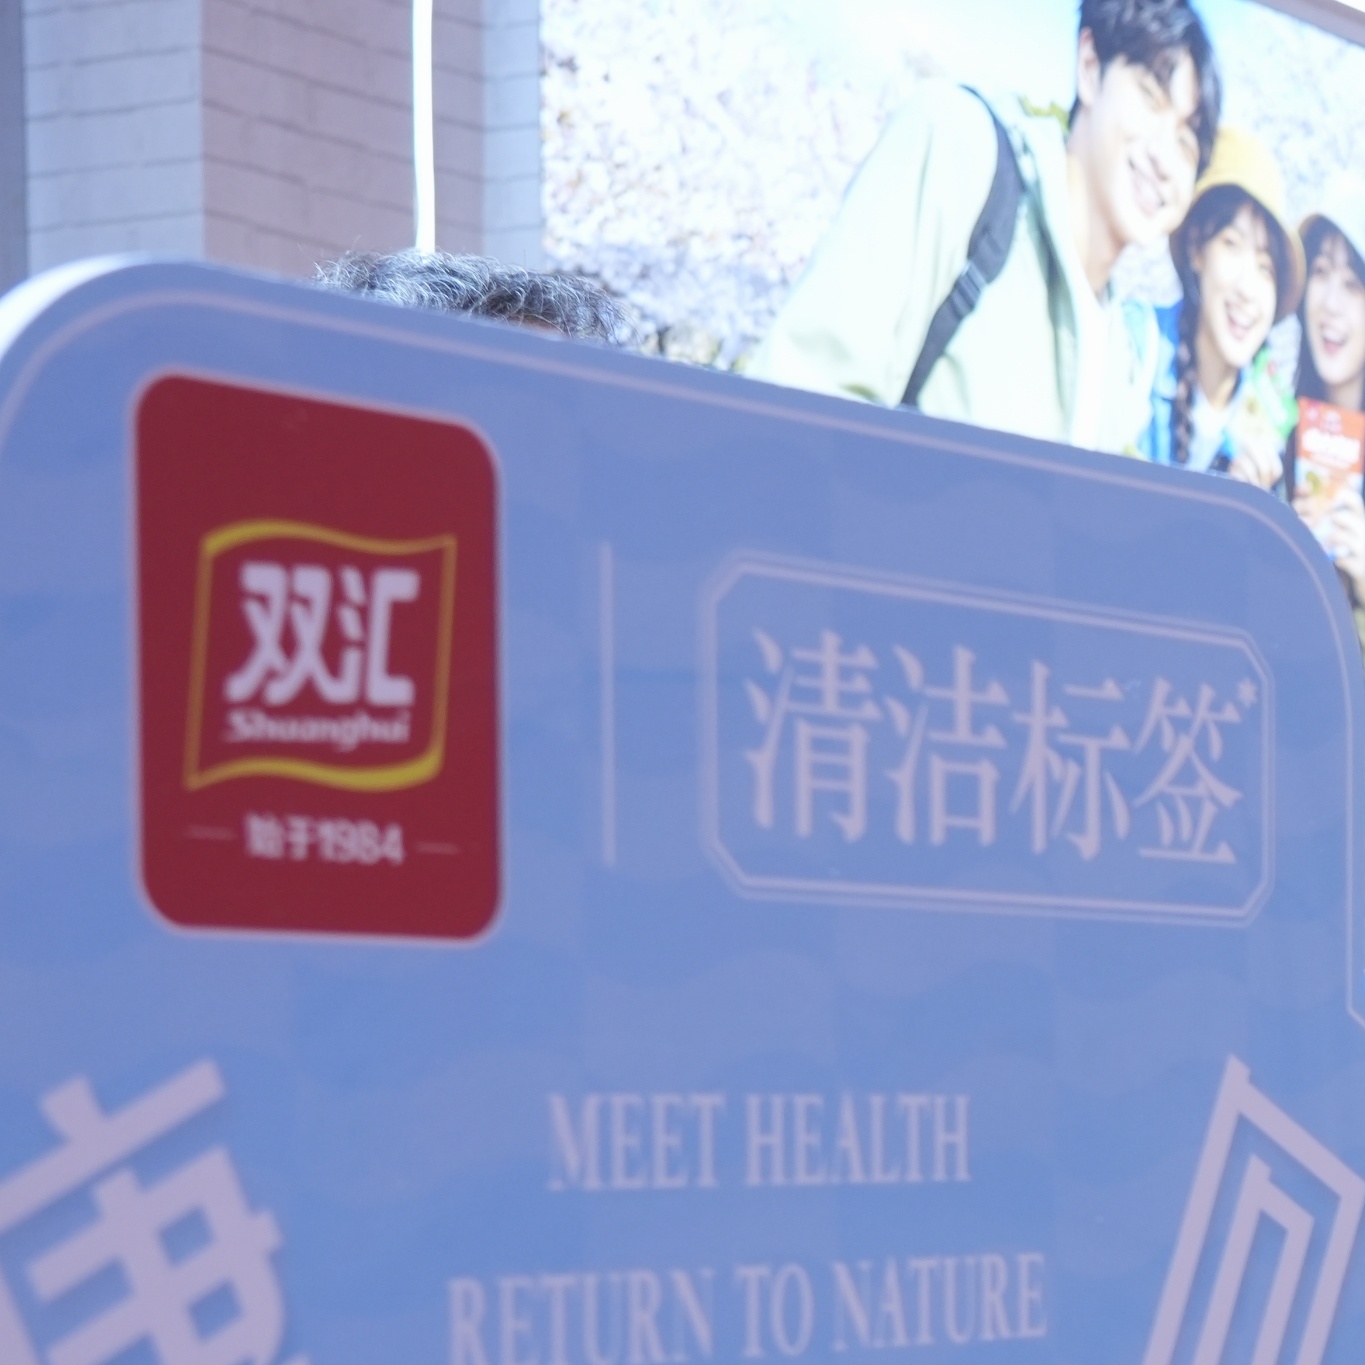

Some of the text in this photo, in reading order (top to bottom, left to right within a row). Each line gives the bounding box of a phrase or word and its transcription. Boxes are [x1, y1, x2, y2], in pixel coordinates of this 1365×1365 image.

[224, 562, 421, 706] 双汇
[226, 709, 410, 750] Shuanghui
[744, 628, 1241, 864] 清洁标签
[244, 814, 407, 864] 始于1984
[547, 1092, 973, 1191] MEET HEALTH
[736, 1263, 814, 1358] TO
[832, 1251, 1050, 1352] NATURE
